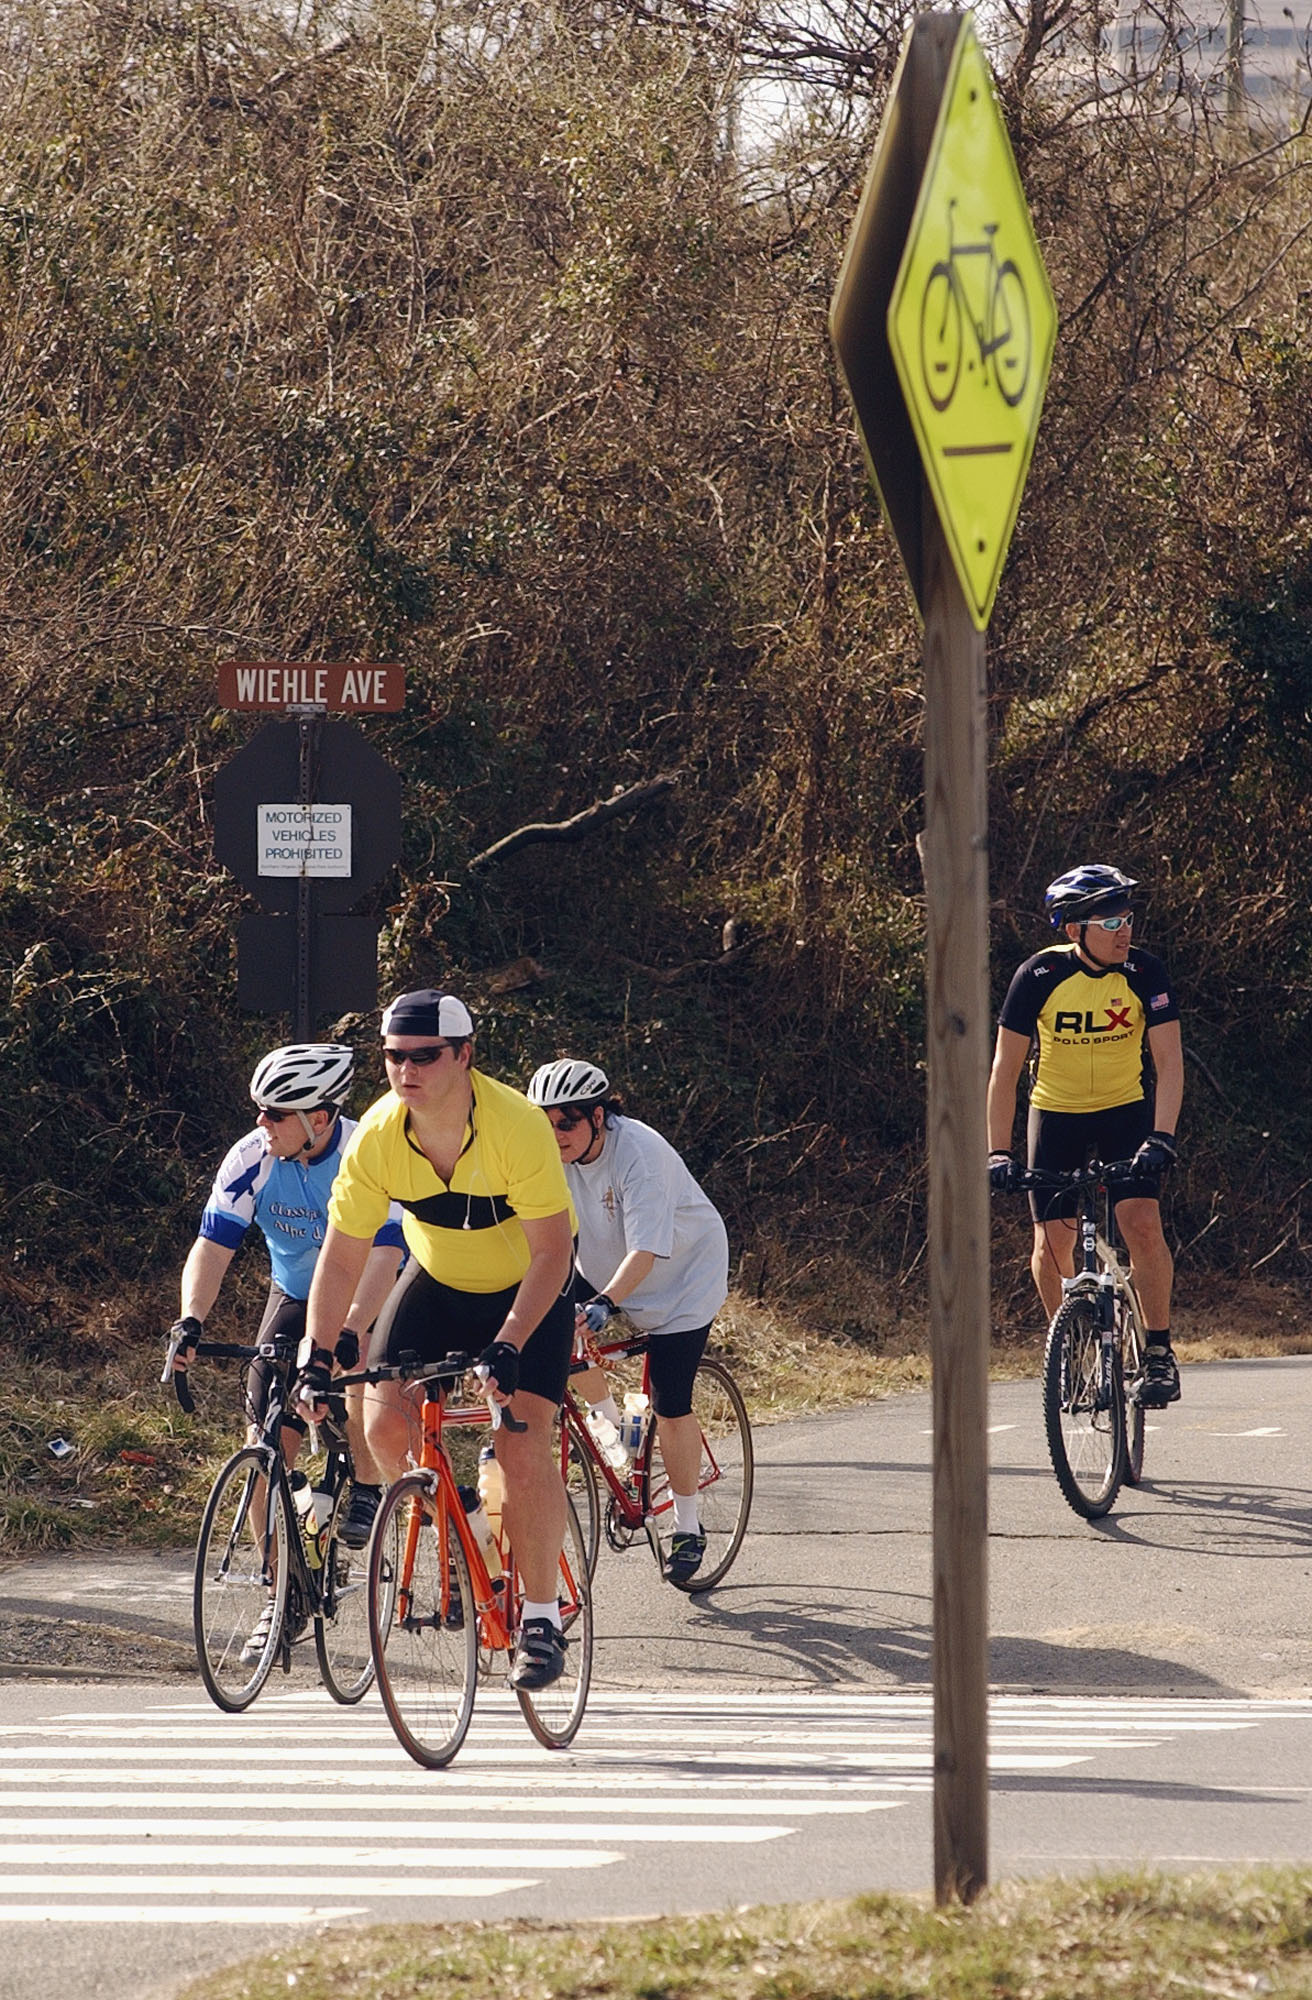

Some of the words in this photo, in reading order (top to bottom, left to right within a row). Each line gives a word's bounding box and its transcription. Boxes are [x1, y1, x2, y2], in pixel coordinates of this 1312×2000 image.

[236, 668, 328, 703] WIEHLE
[341, 670, 387, 704] AVE
[265, 812, 342, 824] MOTORIZED
[272, 830, 336, 842] VEHICLES
[265, 848, 343, 860] PROHIBITED
[1055, 1006, 1134, 1034] RLX
[1053, 1036, 1090, 1045] POLO
[1093, 1029, 1135, 1044] SPORT
